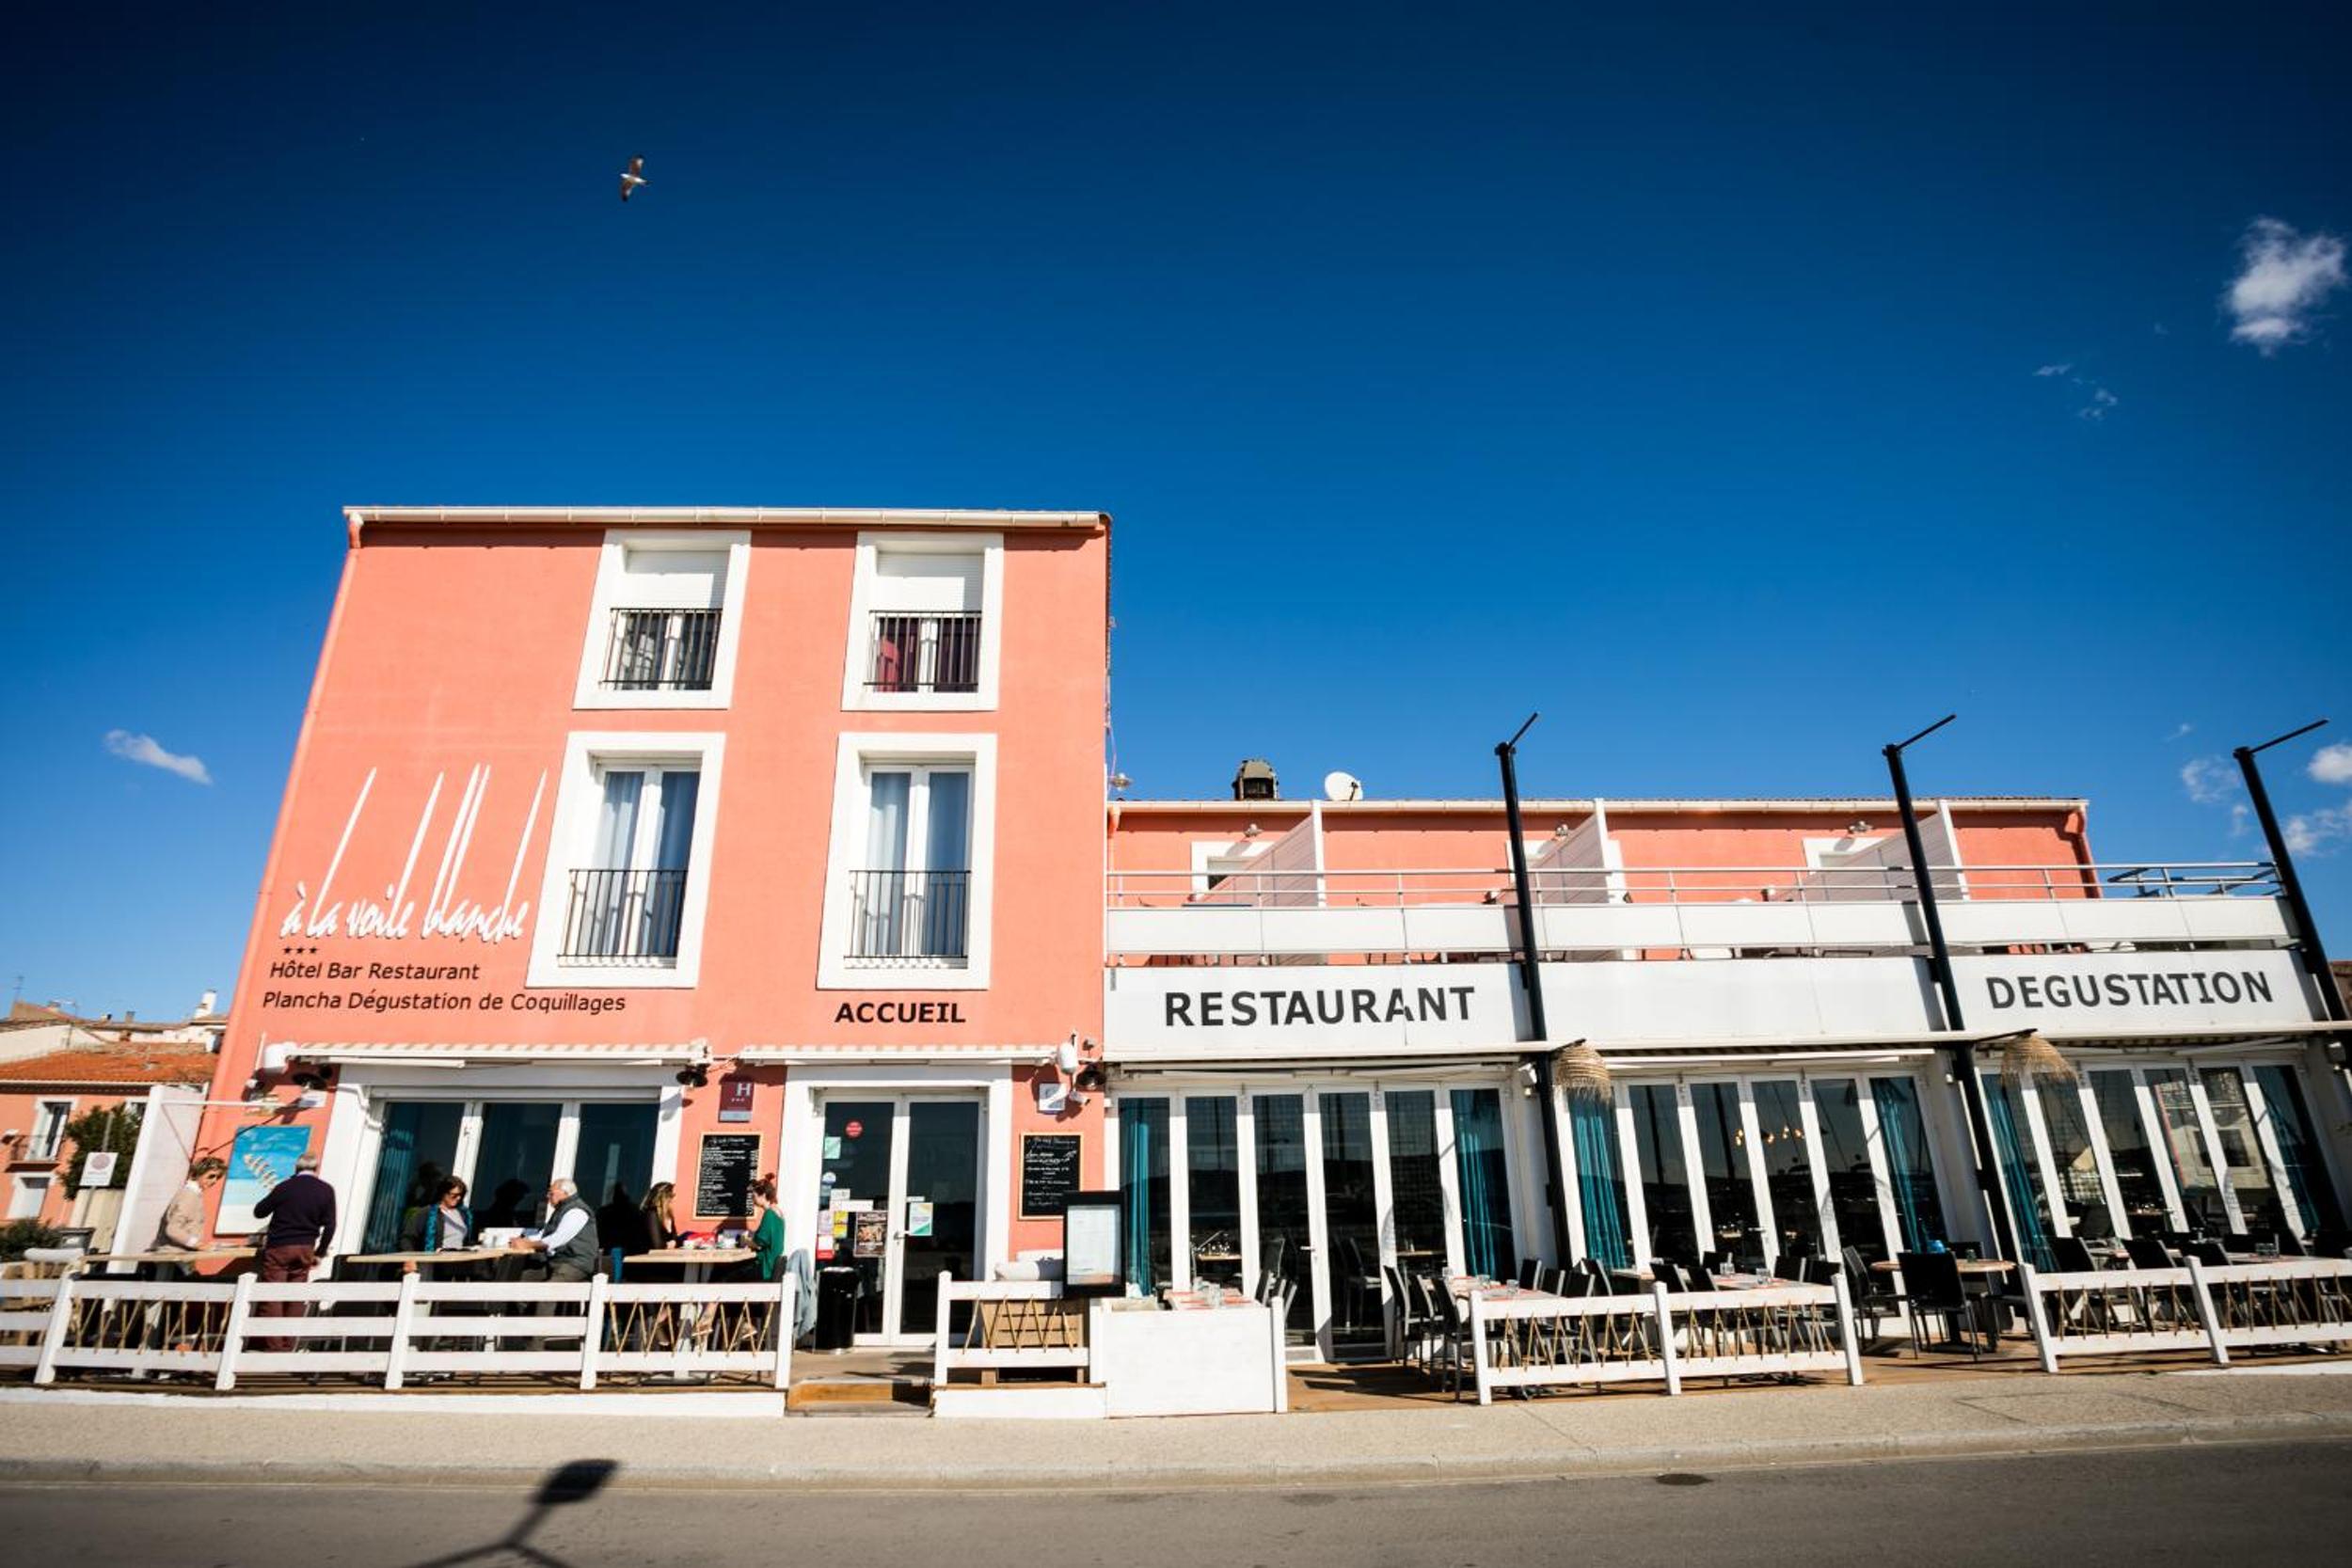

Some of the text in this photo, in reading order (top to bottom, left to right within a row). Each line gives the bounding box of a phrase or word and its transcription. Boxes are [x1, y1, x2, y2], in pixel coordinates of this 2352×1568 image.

[279, 880, 307, 939] à
[270, 959, 481, 980] Hôtel Bar Restaurant
[262, 989, 626, 1016] Plancha Dégustation de Coquillages
[1985, 971, 2273, 1009] DEGUSTATION
[834, 1002, 966, 1023] ACCUEIL
[1165, 986, 1475, 1027] RESTAURANT
[736, 1083, 752, 1098] H
